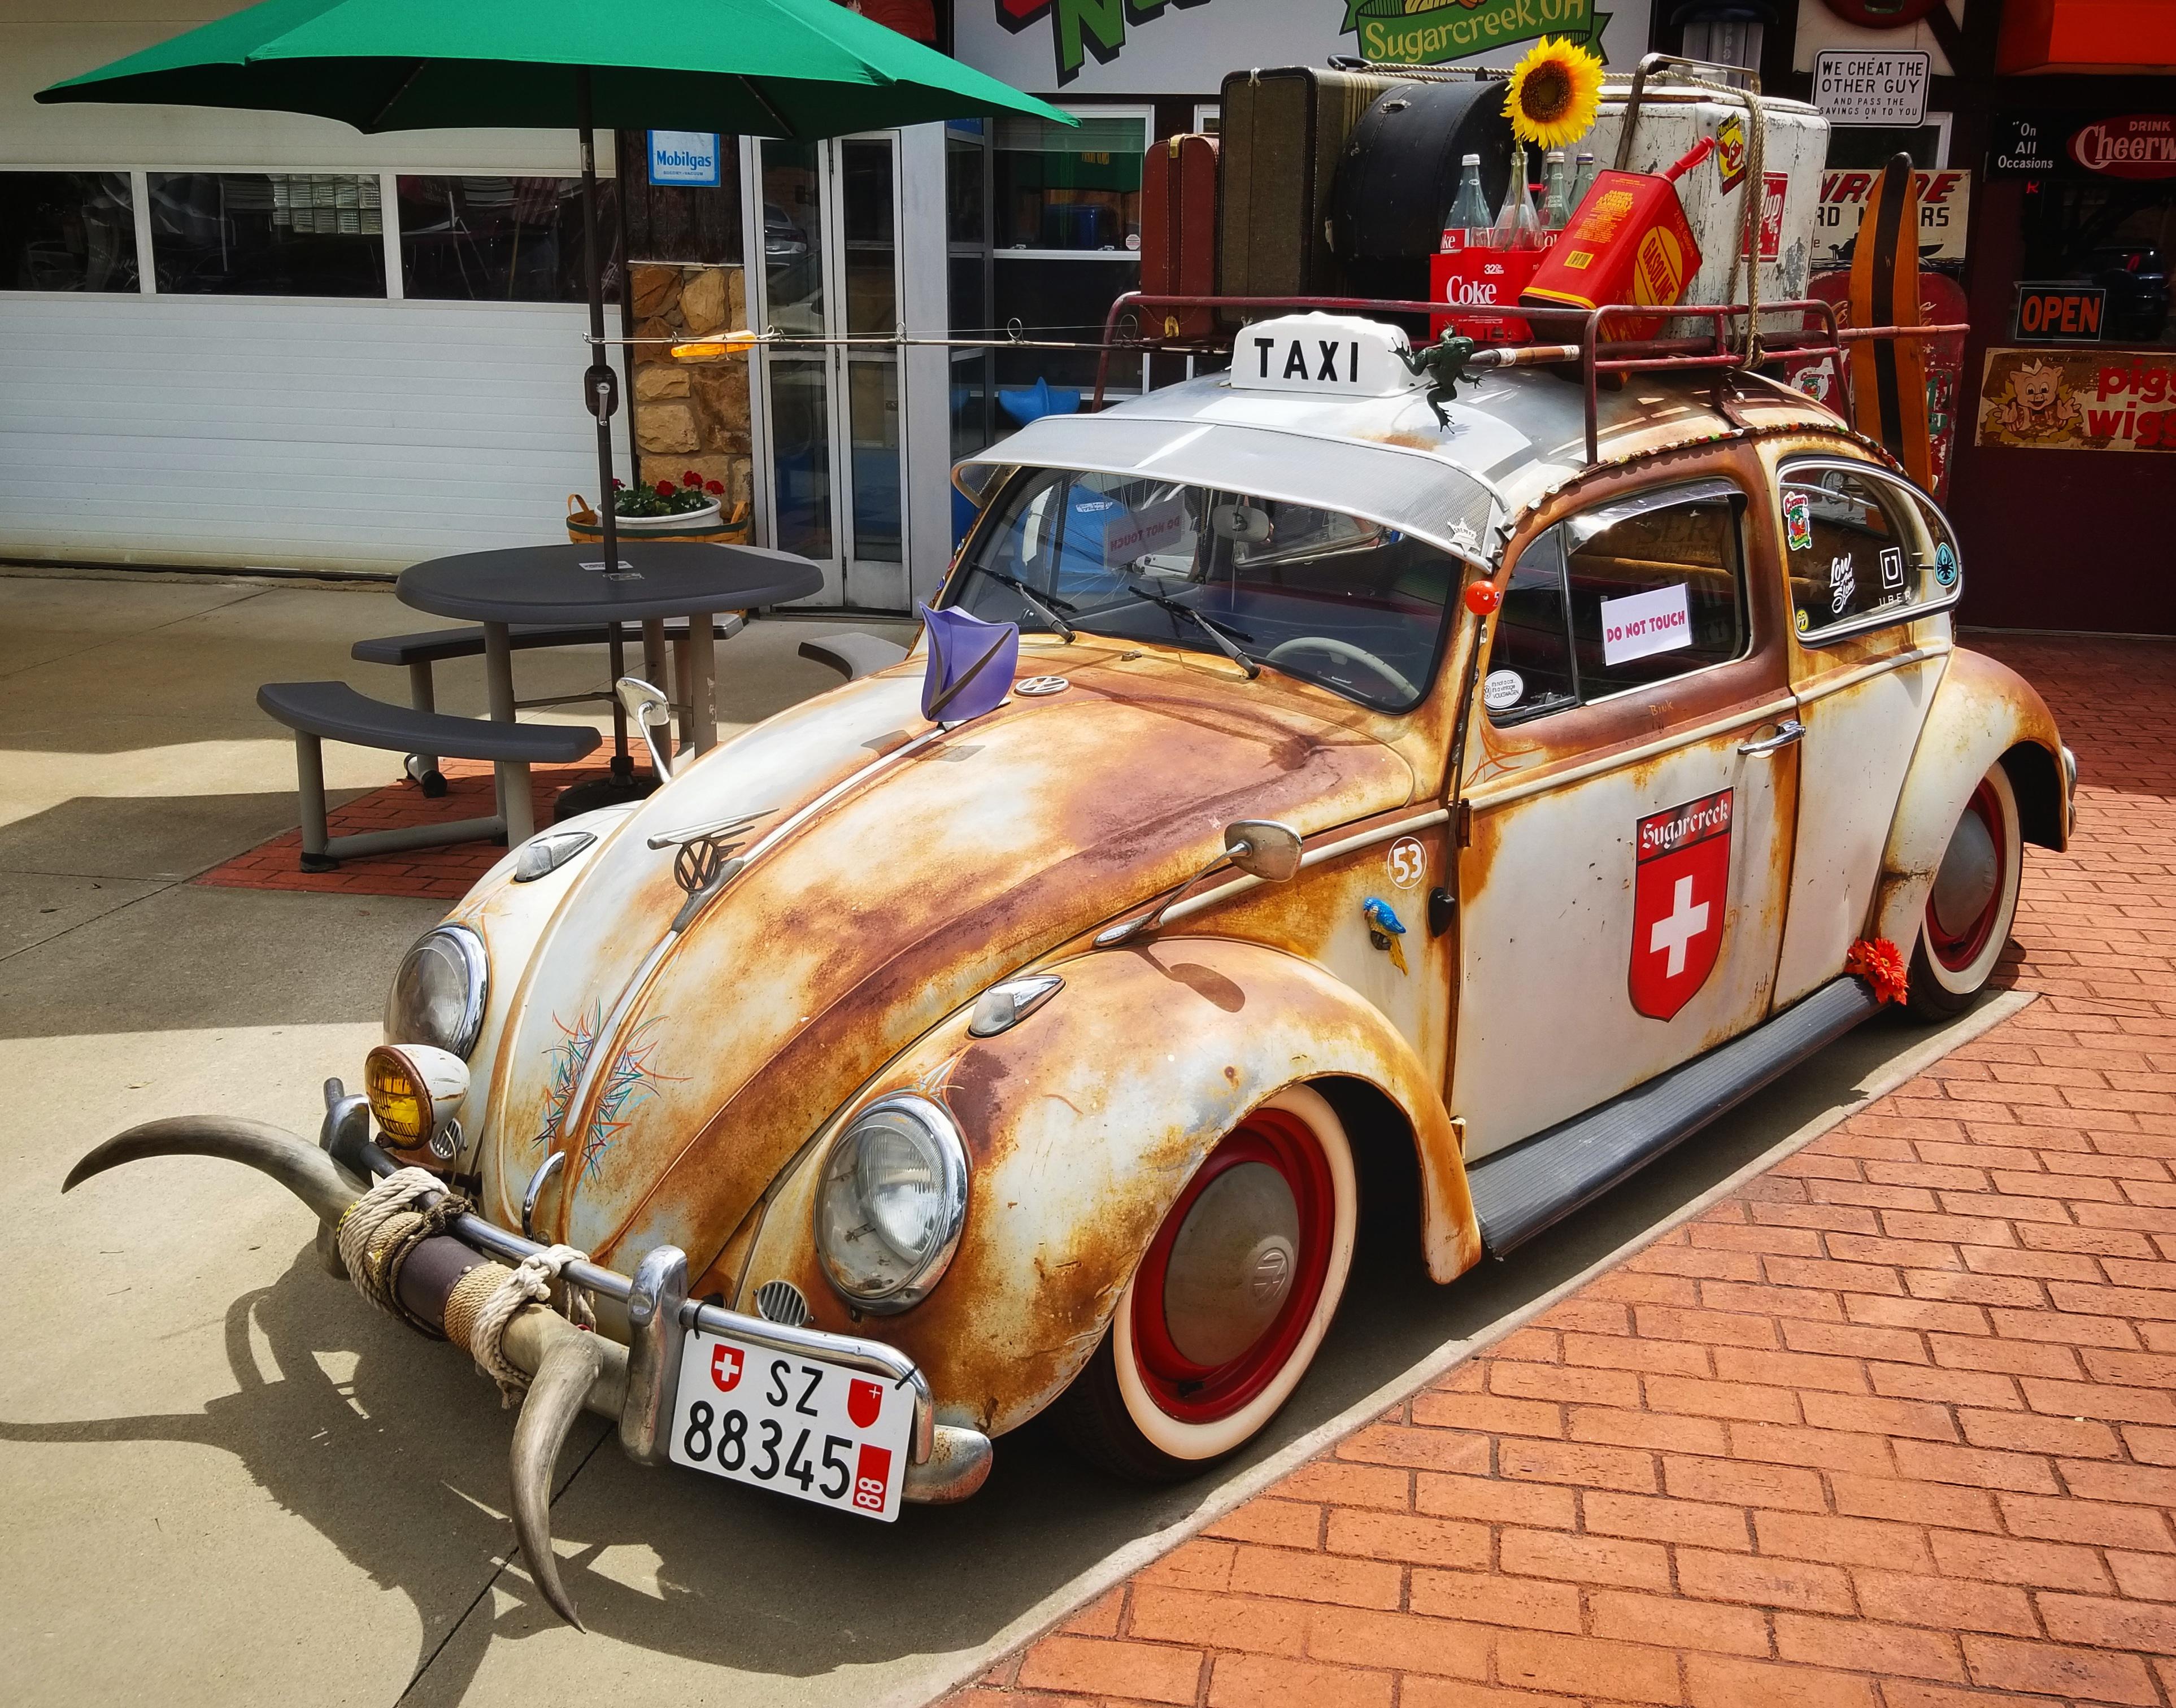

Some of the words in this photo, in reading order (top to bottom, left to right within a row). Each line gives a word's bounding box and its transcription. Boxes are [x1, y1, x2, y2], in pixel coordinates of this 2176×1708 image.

[1822, 61, 1843, 76] WE
[1848, 61, 1892, 76] CHEAT
[1898, 62, 1923, 76] THE
[1822, 79, 1875, 93] OTHER
[1884, 79, 1920, 94] GUY
[1834, 97, 1852, 106] AND
[1819, 107, 1859, 115] SAVINGS
[1882, 107, 1892, 116] TO
[2129, 121, 2171, 132] DRINK
[657, 150, 712, 170] Mobilgas
[1998, 155, 2053, 169] Occasions
[2015, 141, 2036, 154] All
[1643, 237, 1675, 305] GASOLINE
[1446, 275, 1497, 305] Coke
[2022, 295, 2100, 332] OPEN
[1254, 337, 1359, 382] TAXI
[1830, 552, 1851, 588] Low
[1831, 578, 1856, 613] Slow
[1879, 591, 1912, 607] UBER
[1606, 626, 1622, 643] DO
[1625, 621, 1647, 639] NOT
[1649, 610, 1685, 633] TOUCH
[1642, 798, 1729, 849] Sugarcreek
[1393, 844, 1422, 883] 53
[766, 1360, 824, 1417] SZ
[684, 1400, 853, 1500] 88345
[856, 1476, 884, 1509] 88
